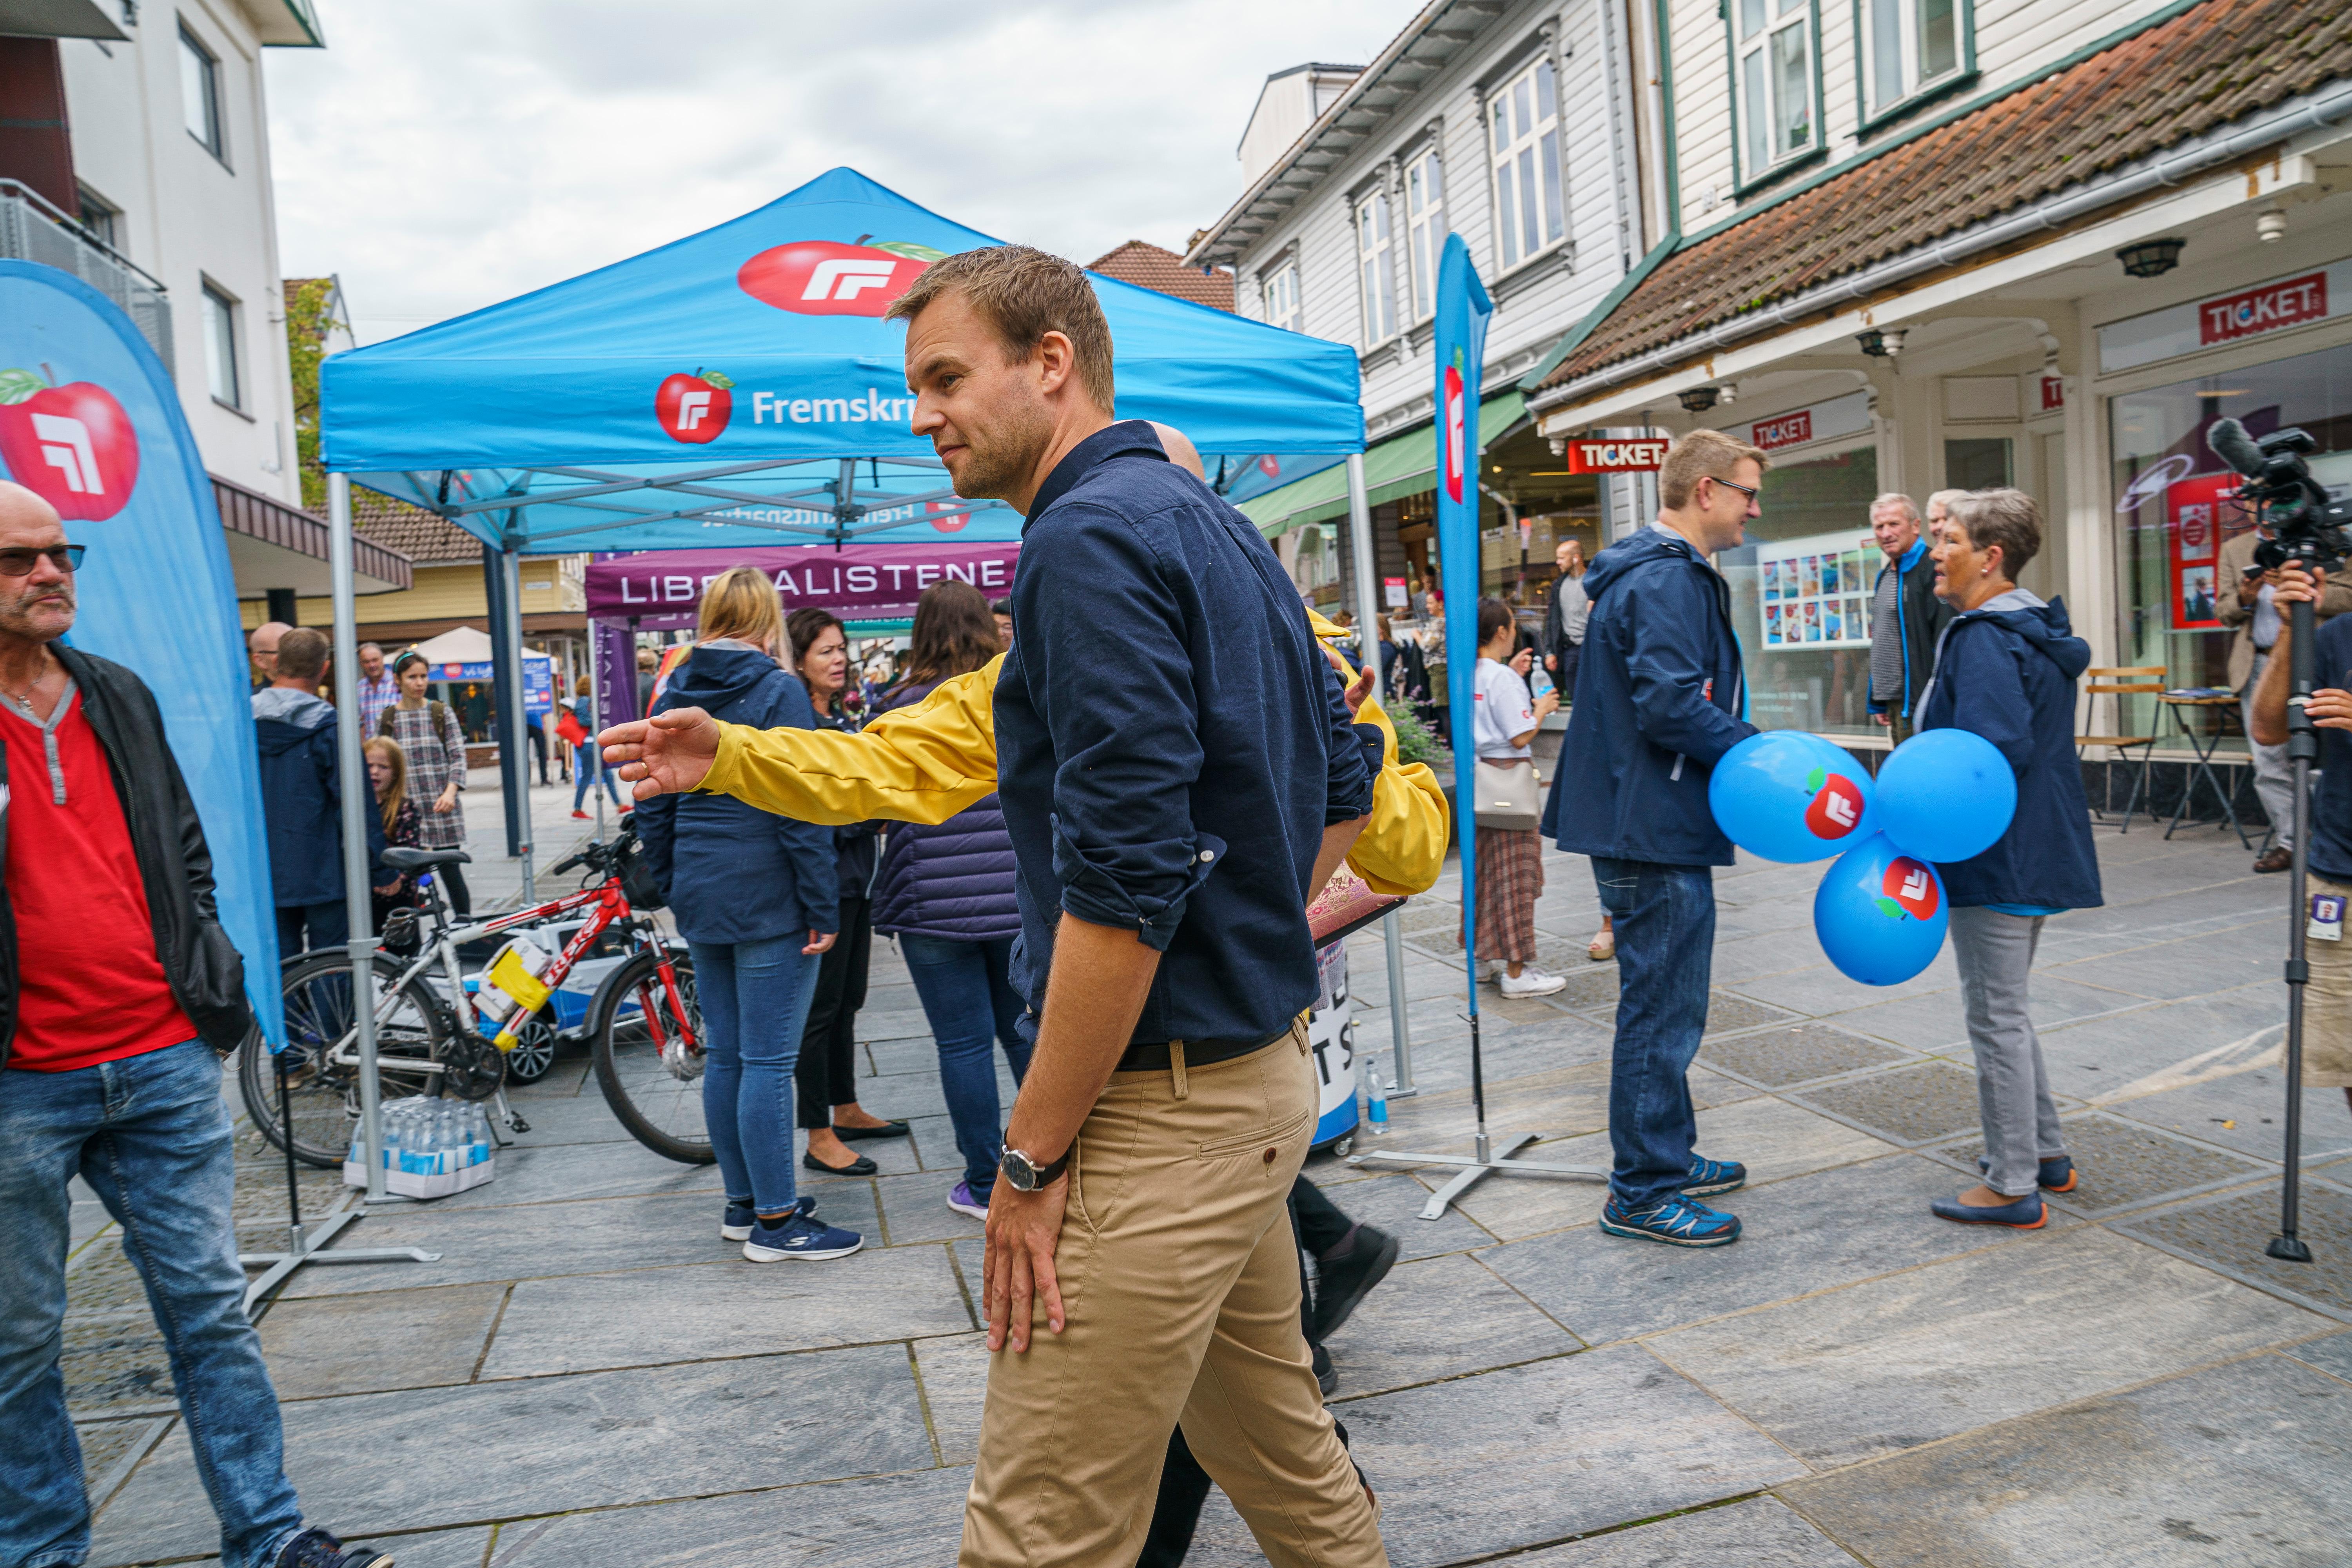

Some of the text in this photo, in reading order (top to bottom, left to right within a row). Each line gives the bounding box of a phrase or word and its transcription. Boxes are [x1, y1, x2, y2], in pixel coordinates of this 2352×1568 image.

[2207, 282, 2317, 334] TICKET
[1756, 417, 1806, 446] TICKET
[1580, 443, 1664, 466] TICKET
[621, 560, 1006, 603] LIBALISTENE
